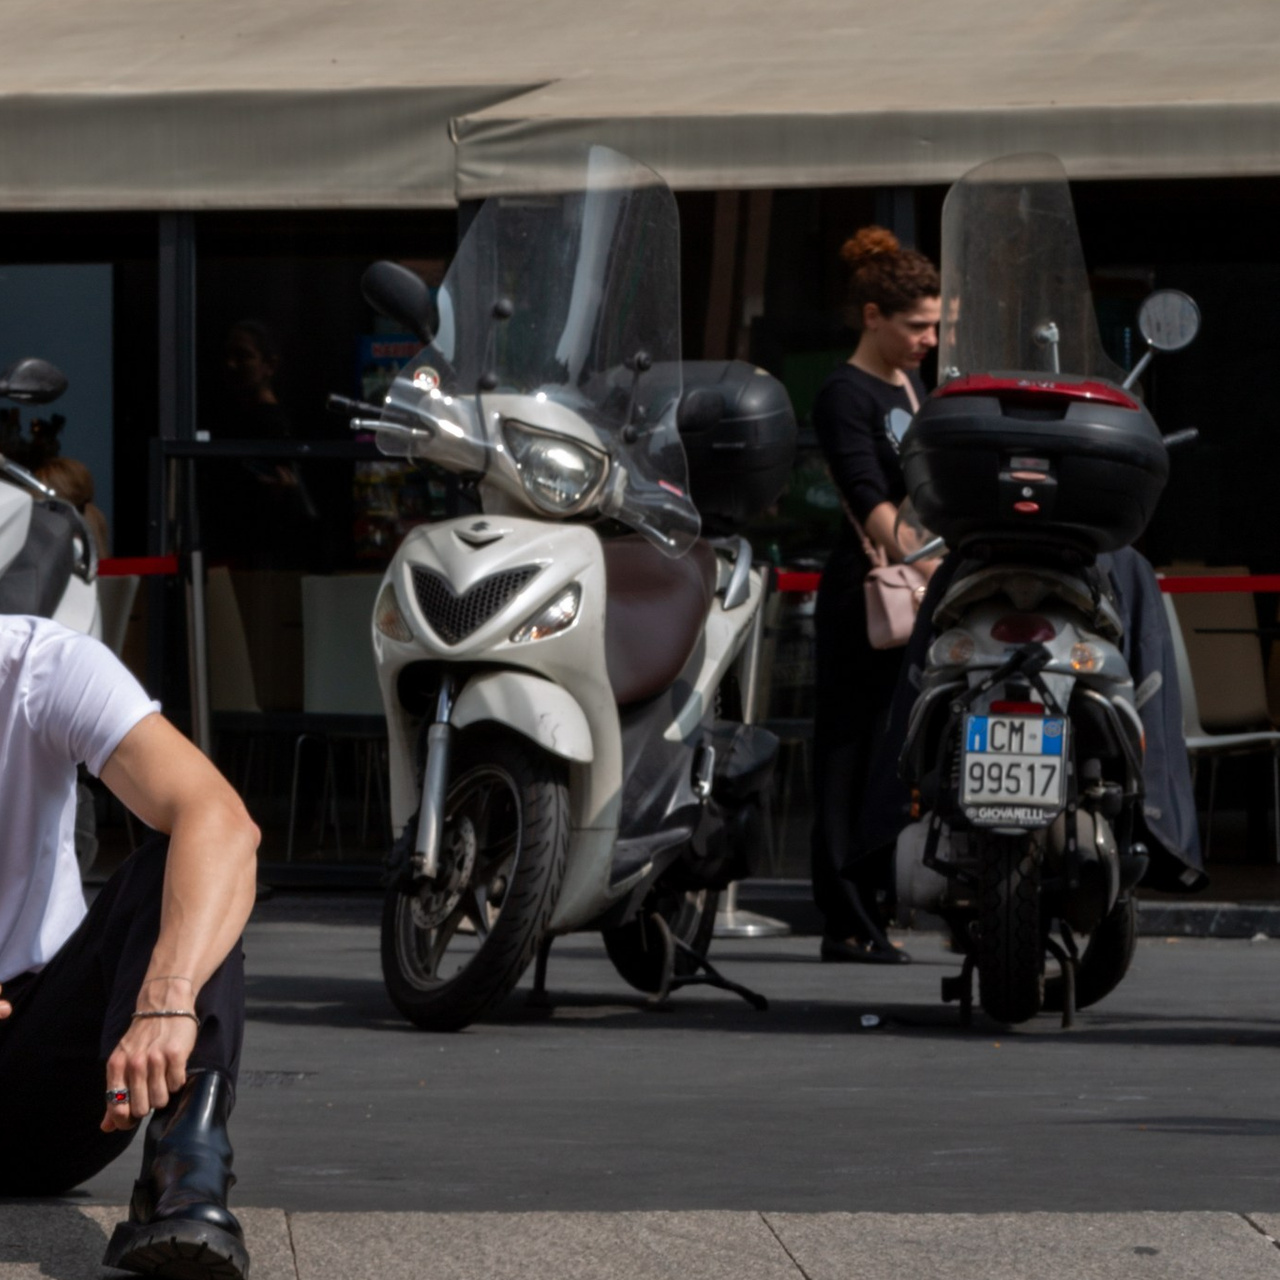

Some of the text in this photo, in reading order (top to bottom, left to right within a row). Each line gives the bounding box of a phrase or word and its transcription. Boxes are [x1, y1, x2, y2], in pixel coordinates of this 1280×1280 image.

[990, 720, 1025, 752] CM
[969, 762, 1057, 797] 99517
[978, 806, 1044, 820] GIOVANELLI
